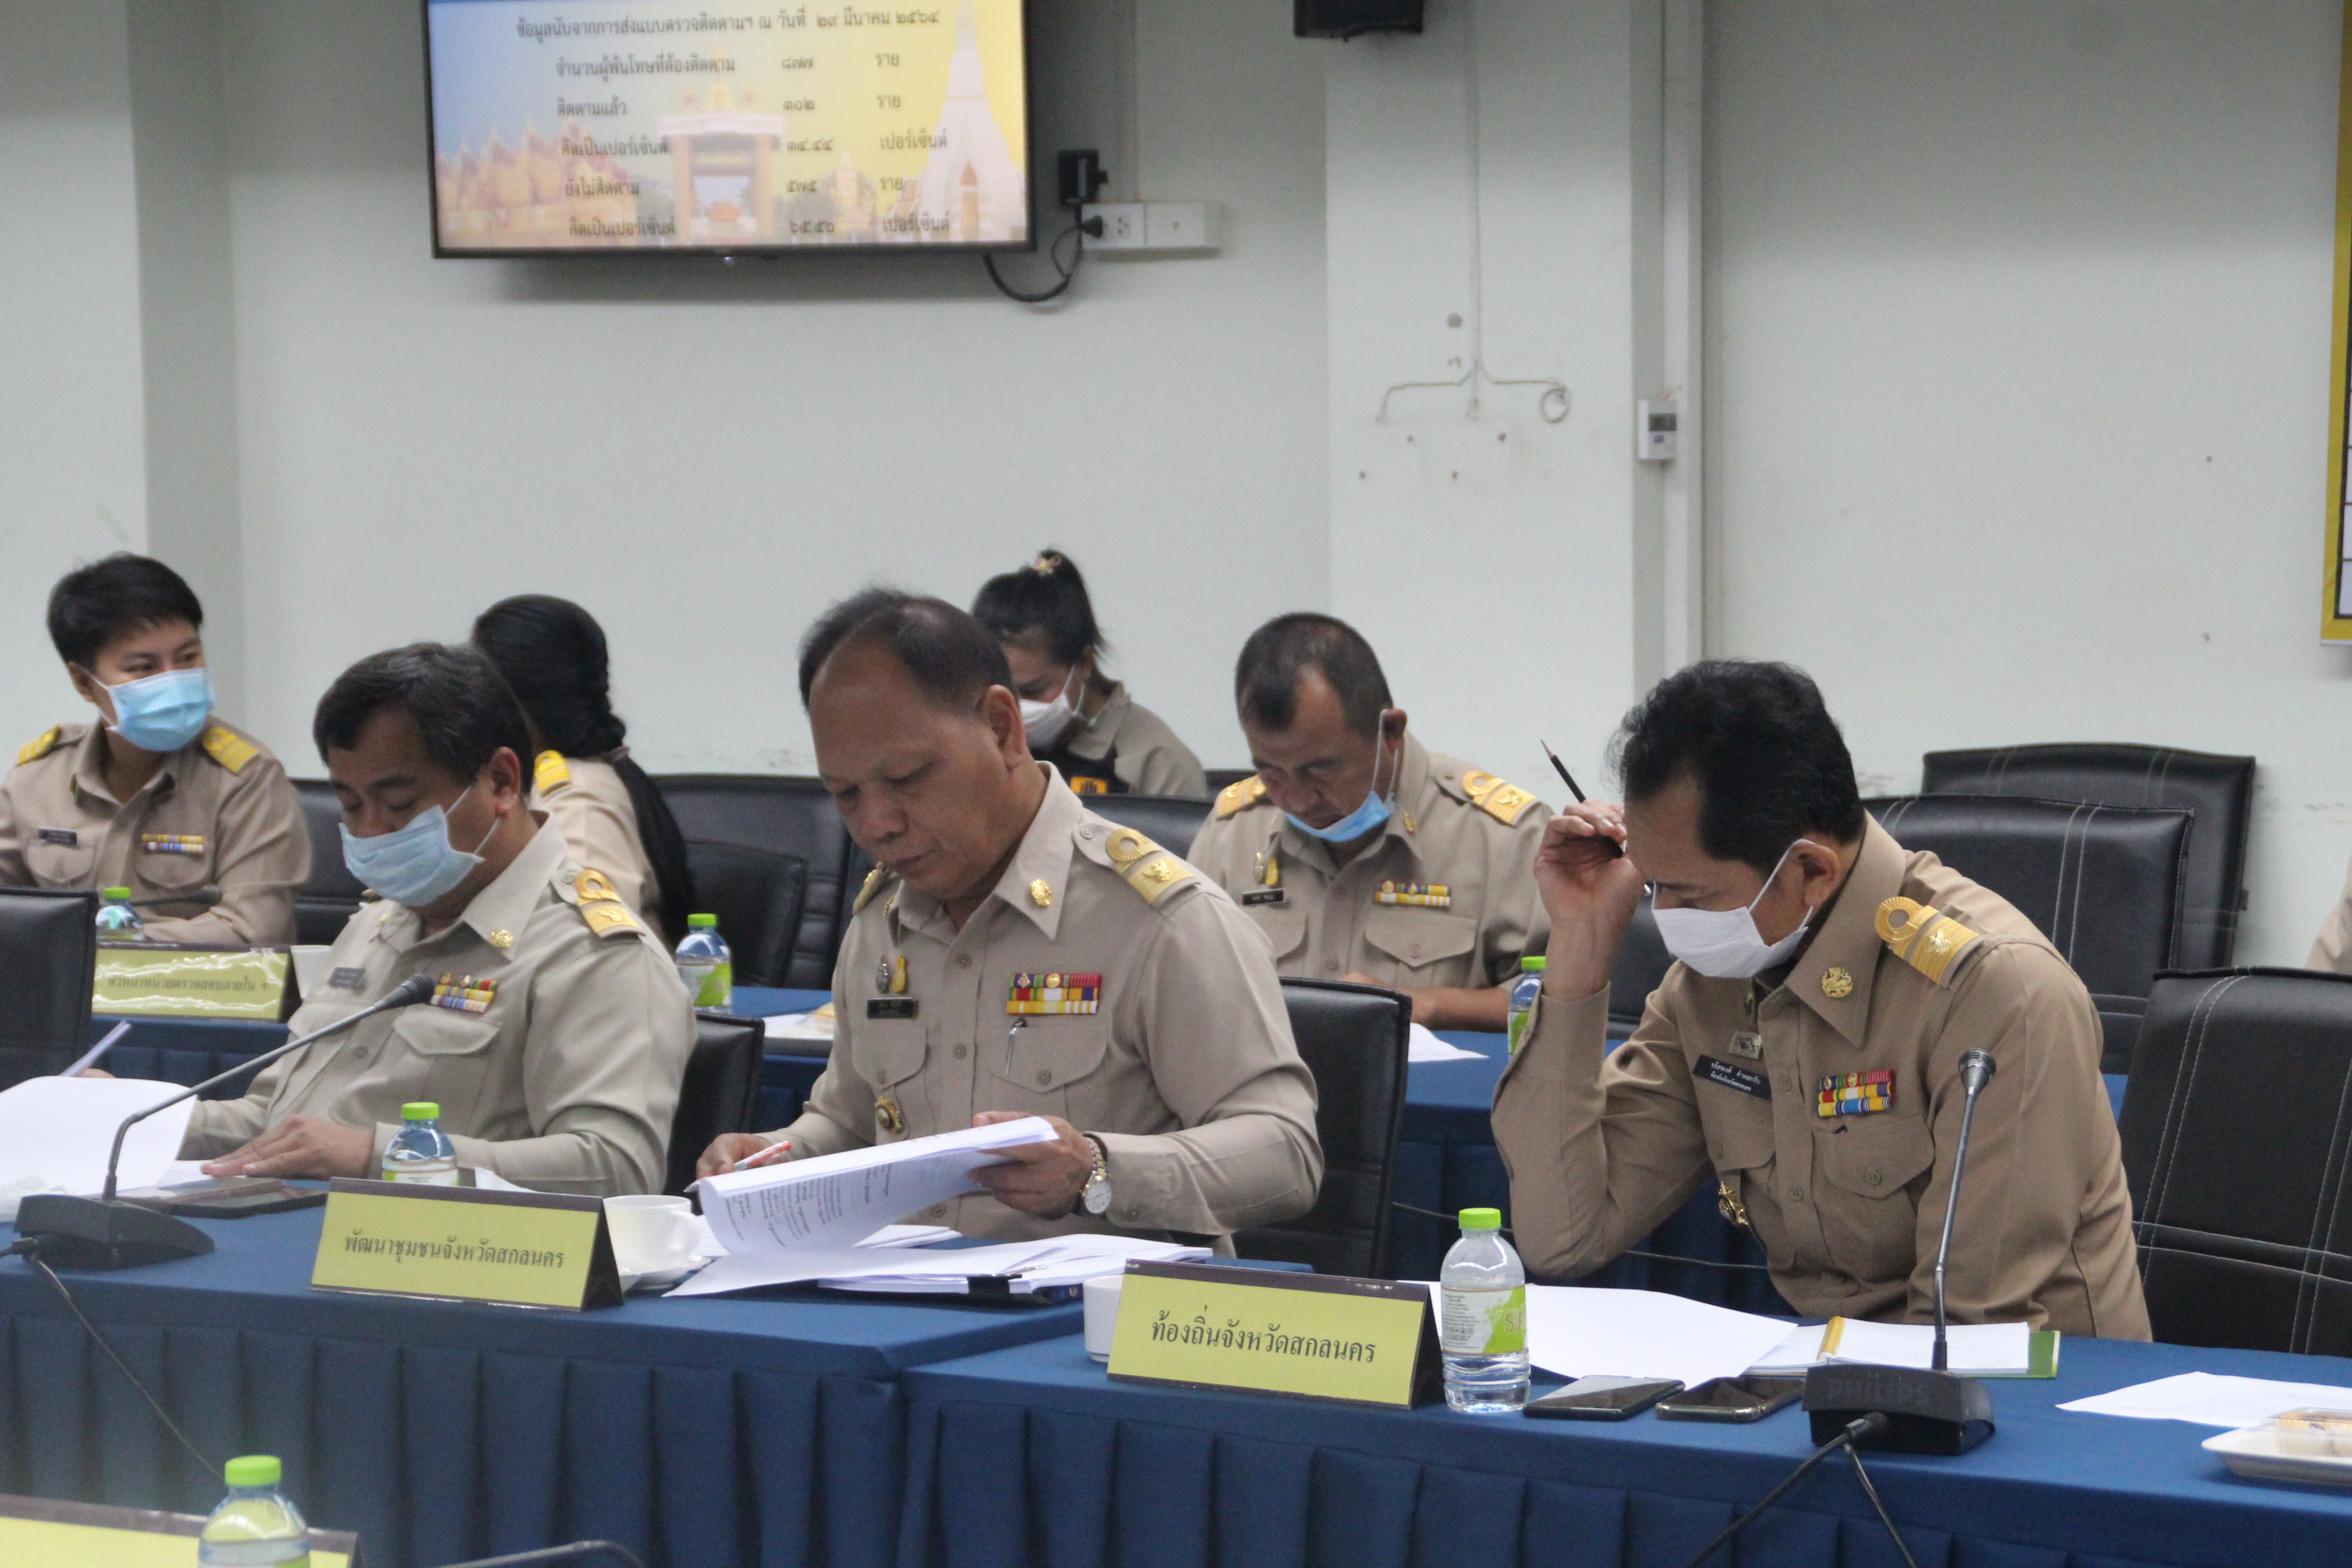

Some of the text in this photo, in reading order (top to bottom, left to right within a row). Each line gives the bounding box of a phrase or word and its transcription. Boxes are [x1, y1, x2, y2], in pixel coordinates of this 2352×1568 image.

[759, 15, 771, 29] ณ
[778, 3, 806, 28] วันที่
[843, 5, 890, 26] มีนาคม
[875, 53, 900, 67] ราย
[557, 94, 627, 115] ติดตามแล้ว
[876, 94, 901, 108] ราย
[561, 134, 667, 156] คิดเป็นเปอร์เซ็นต์
[880, 127, 947, 150] เปอร์เซ็นต์
[879, 176, 903, 191] ราย
[344, 1228, 564, 1269] พัฒนาชุมชนจังหวัดสกลนคร
[1151, 1304, 1377, 1363] ท้องถิ่นจังหวัดสกลนคร
[1827, 1377, 1929, 1406] PHILIPS
